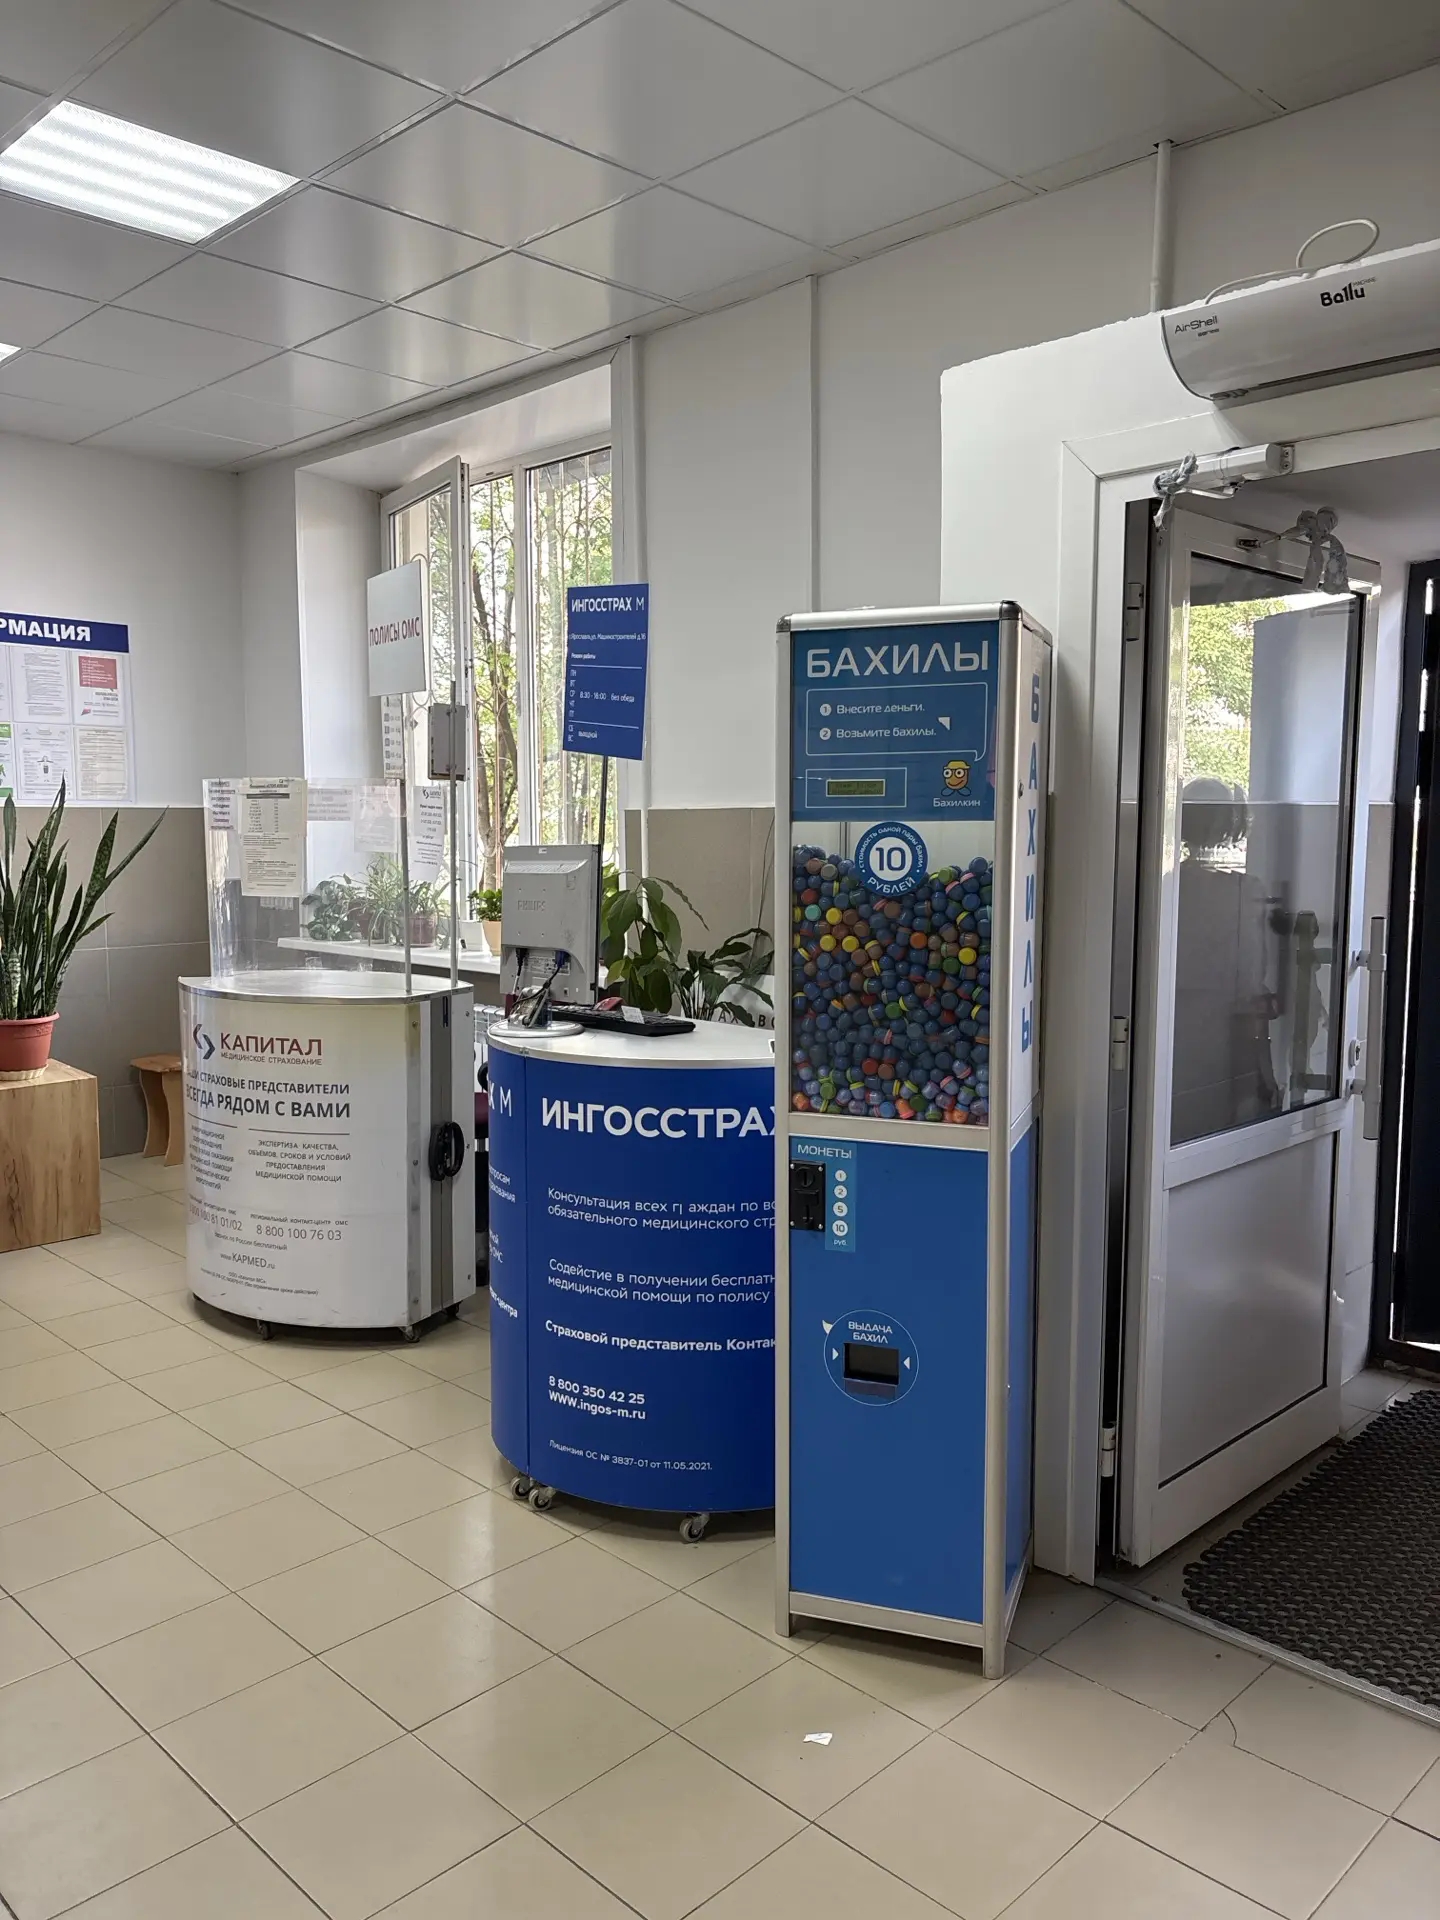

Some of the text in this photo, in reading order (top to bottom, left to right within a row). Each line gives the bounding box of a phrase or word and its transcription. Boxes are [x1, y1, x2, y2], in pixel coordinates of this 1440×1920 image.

[1320, 282, 1365, 306] Ballu
[1174, 316, 1218, 334] AirShell
[572, 596, 644, 612] ИНГОССТРАХ М
[370, 616, 420, 646] ПОЛИСЫ ОМС
[807, 640, 988, 678] БАХИЛЫ
[837, 704, 882, 714] Внесите
[884, 704, 925, 713] деньги.
[837, 729, 890, 738] Возьмите
[893, 726, 936, 737] бахилы.
[933, 798, 980, 807] Бахилкин
[876, 847, 906, 871] 10
[1022, 673, 1039, 1052] БАХИЛЫ
[867, 876, 916, 893] РУБЛЕЙ
[220, 1032, 322, 1056] КАПИТАЛ
[221, 1052, 322, 1065] МЕДИЦИНСКОЕ СТРАХОВАНИЕ
[187, 1070, 349, 1094] АШИ СТРАХОВЫЕ ПРЕДСТАВИТЕЛИ
[186, 1084, 350, 1118] ВСЕГДА РЯДОМ С ВАМИ
[258, 1140, 298, 1149] ЭКСПЕРТИЗА
[797, 1144, 852, 1159] МОНЕТЫ
[255, 1170, 304, 1181] МЕДИЦИНСКОЙ
[266, 1162, 325, 1171] ПРЕДОСТАВЛЕНИЯ
[548, 1187, 630, 1211] Консультация
[635, 1200, 668, 1213] всех
[741, 1202, 759, 1212] по
[220, 1216, 242, 1231] 01/02
[548, 1204, 637, 1227] обязательного
[642, 1215, 749, 1230] медицинского
[256, 1224, 341, 1240] 8 800 100 76 03
[254, 1240, 288, 1250] бесплатный
[549, 1258, 612, 1281] Содейстие
[617, 1274, 624, 1282] в
[629, 1275, 708, 1288] получении
[548, 1276, 770, 1304] медицинской помощи по полису
[545, 1320, 608, 1344] Страховой
[612, 1336, 722, 1351] представитель
[848, 1321, 893, 1334] ВЫДАЧА
[853, 1332, 888, 1344] БАХИЛ
[549, 1376, 645, 1404] 8 800 350 42 25
[550, 1440, 583, 1457] Лицензия
[586, 1451, 598, 1461] ОС
[612, 1455, 648, 1467] 3837-01
[664, 1460, 712, 1470] 11.05.2021.
